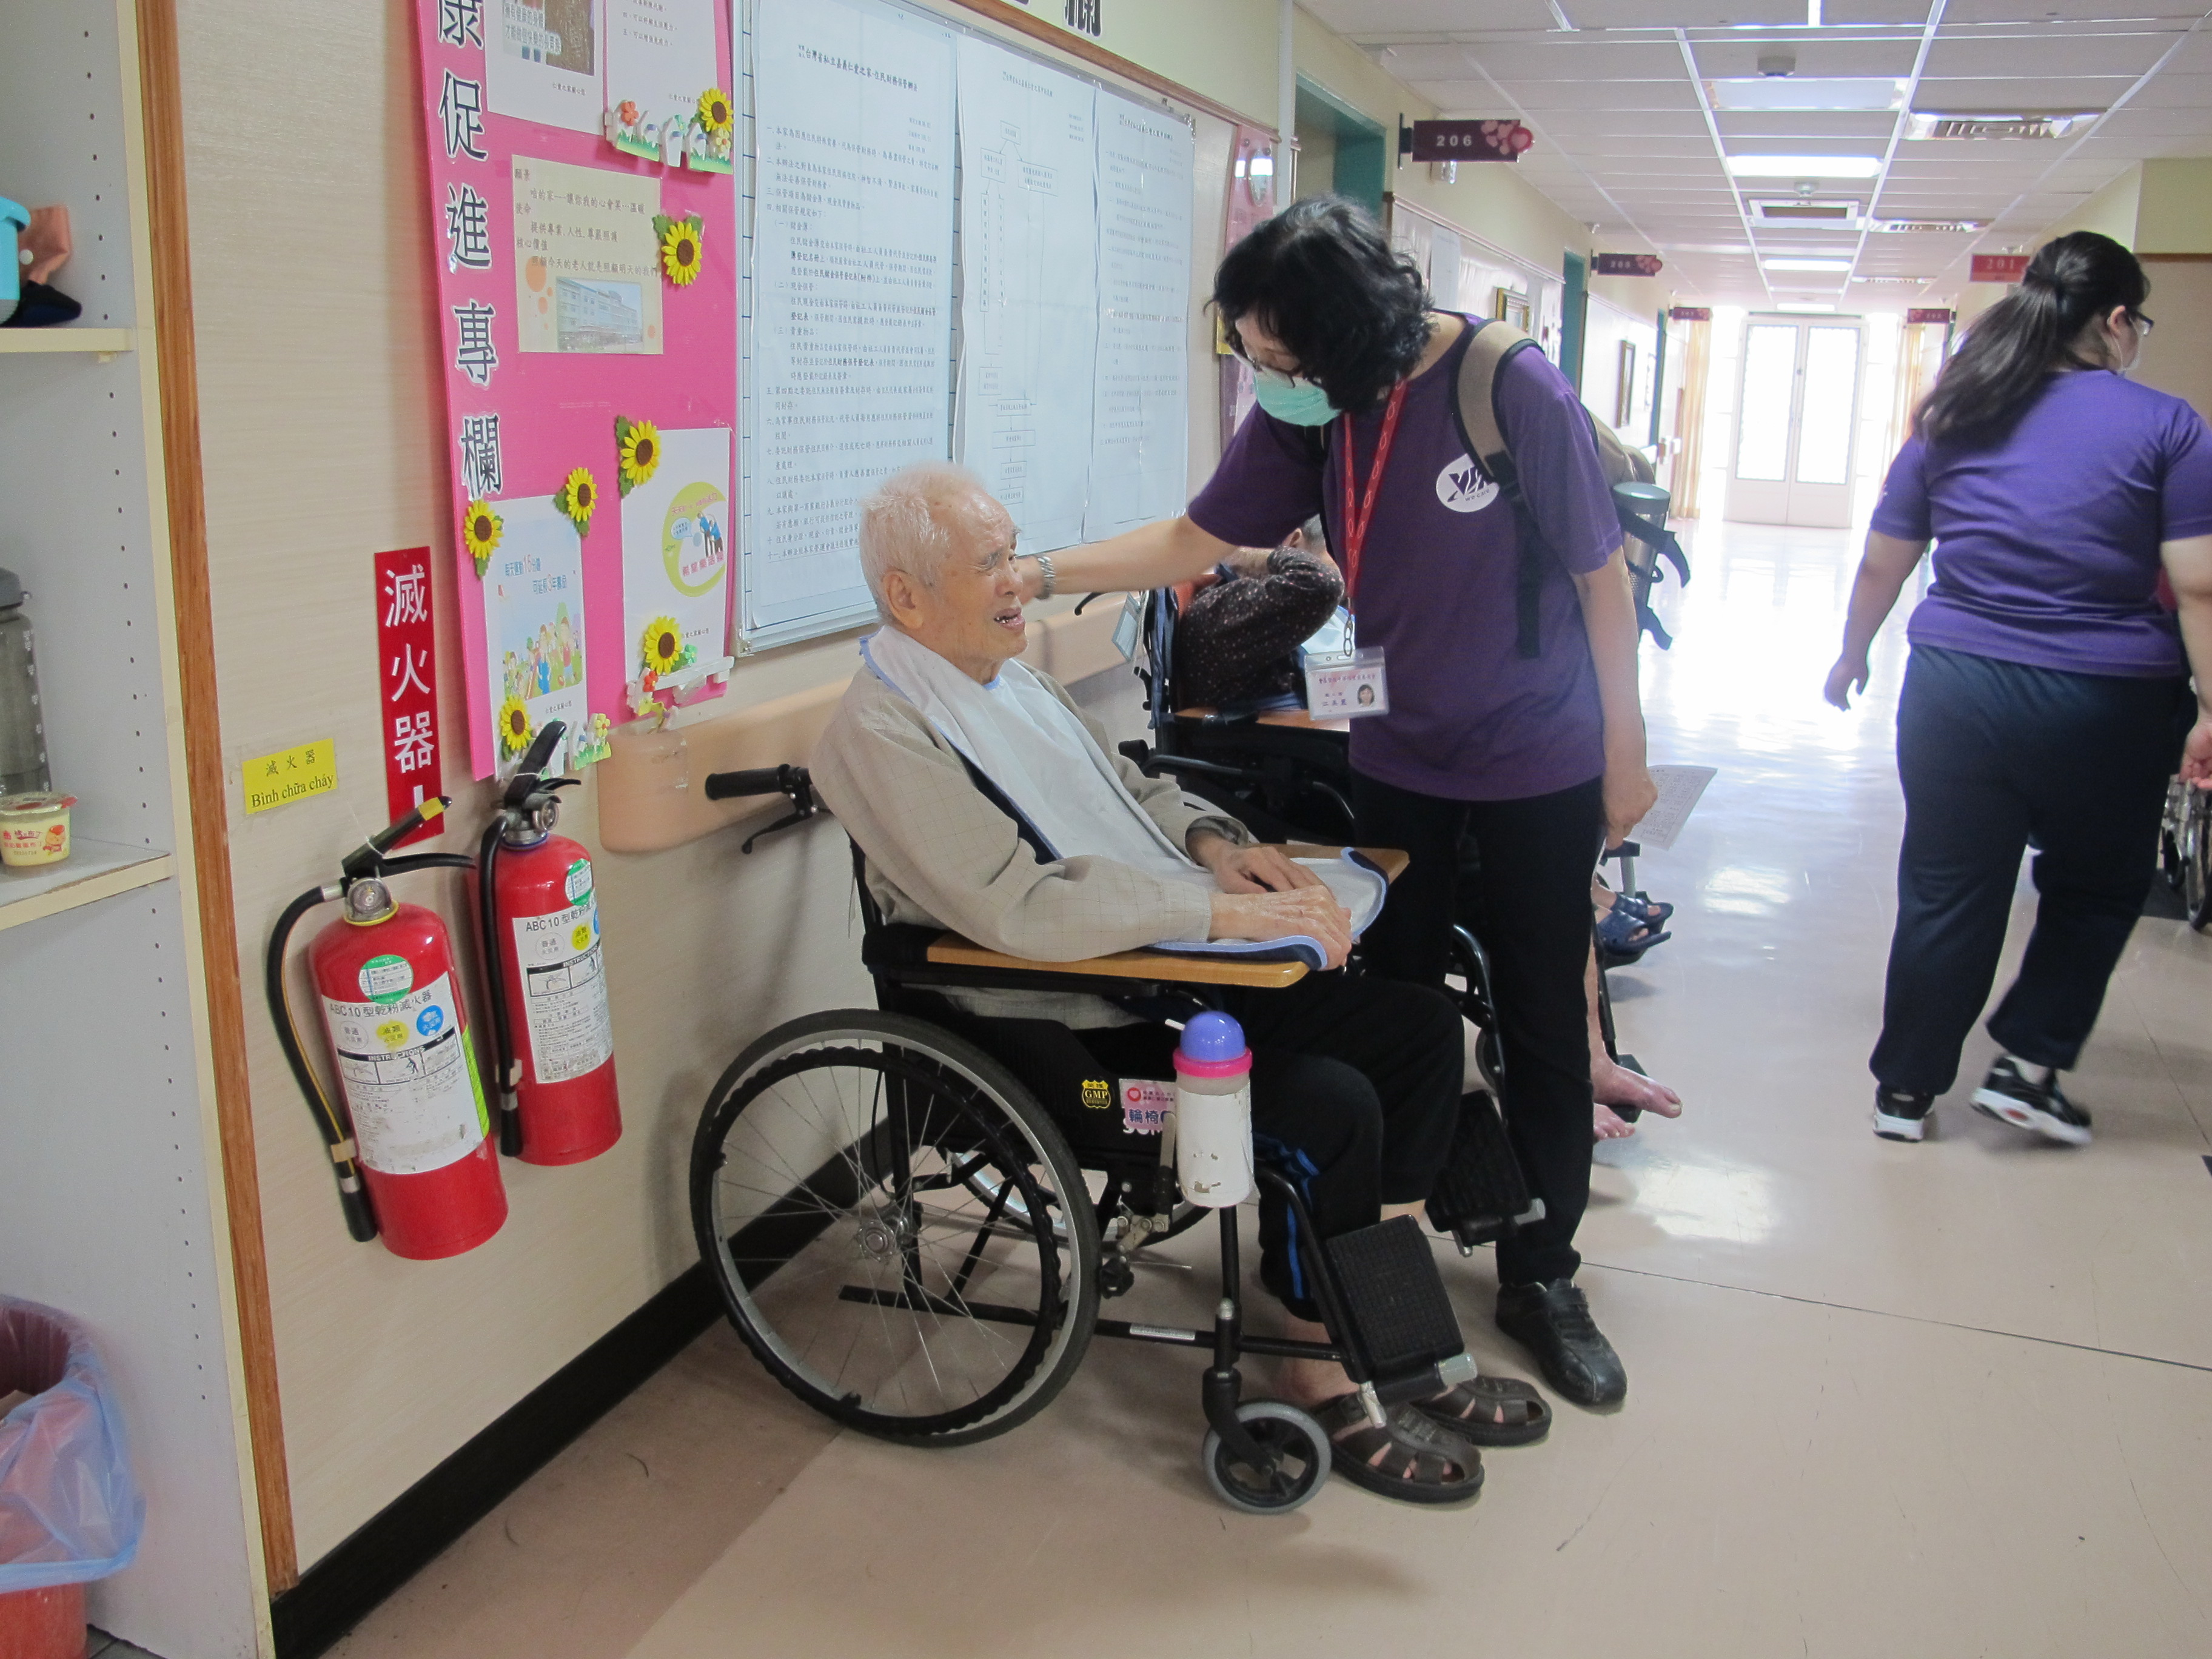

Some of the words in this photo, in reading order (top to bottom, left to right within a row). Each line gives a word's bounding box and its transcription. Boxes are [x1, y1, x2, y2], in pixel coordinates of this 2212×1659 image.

[1436, 135, 1472, 147] 206
[1986, 259, 2015, 269] 201
[384, 563, 435, 774] 滅火器
[266, 749, 315, 777] 滅火器
[309, 773, 333, 789] cháy
[1085, 1090, 1108, 1099] GMP
